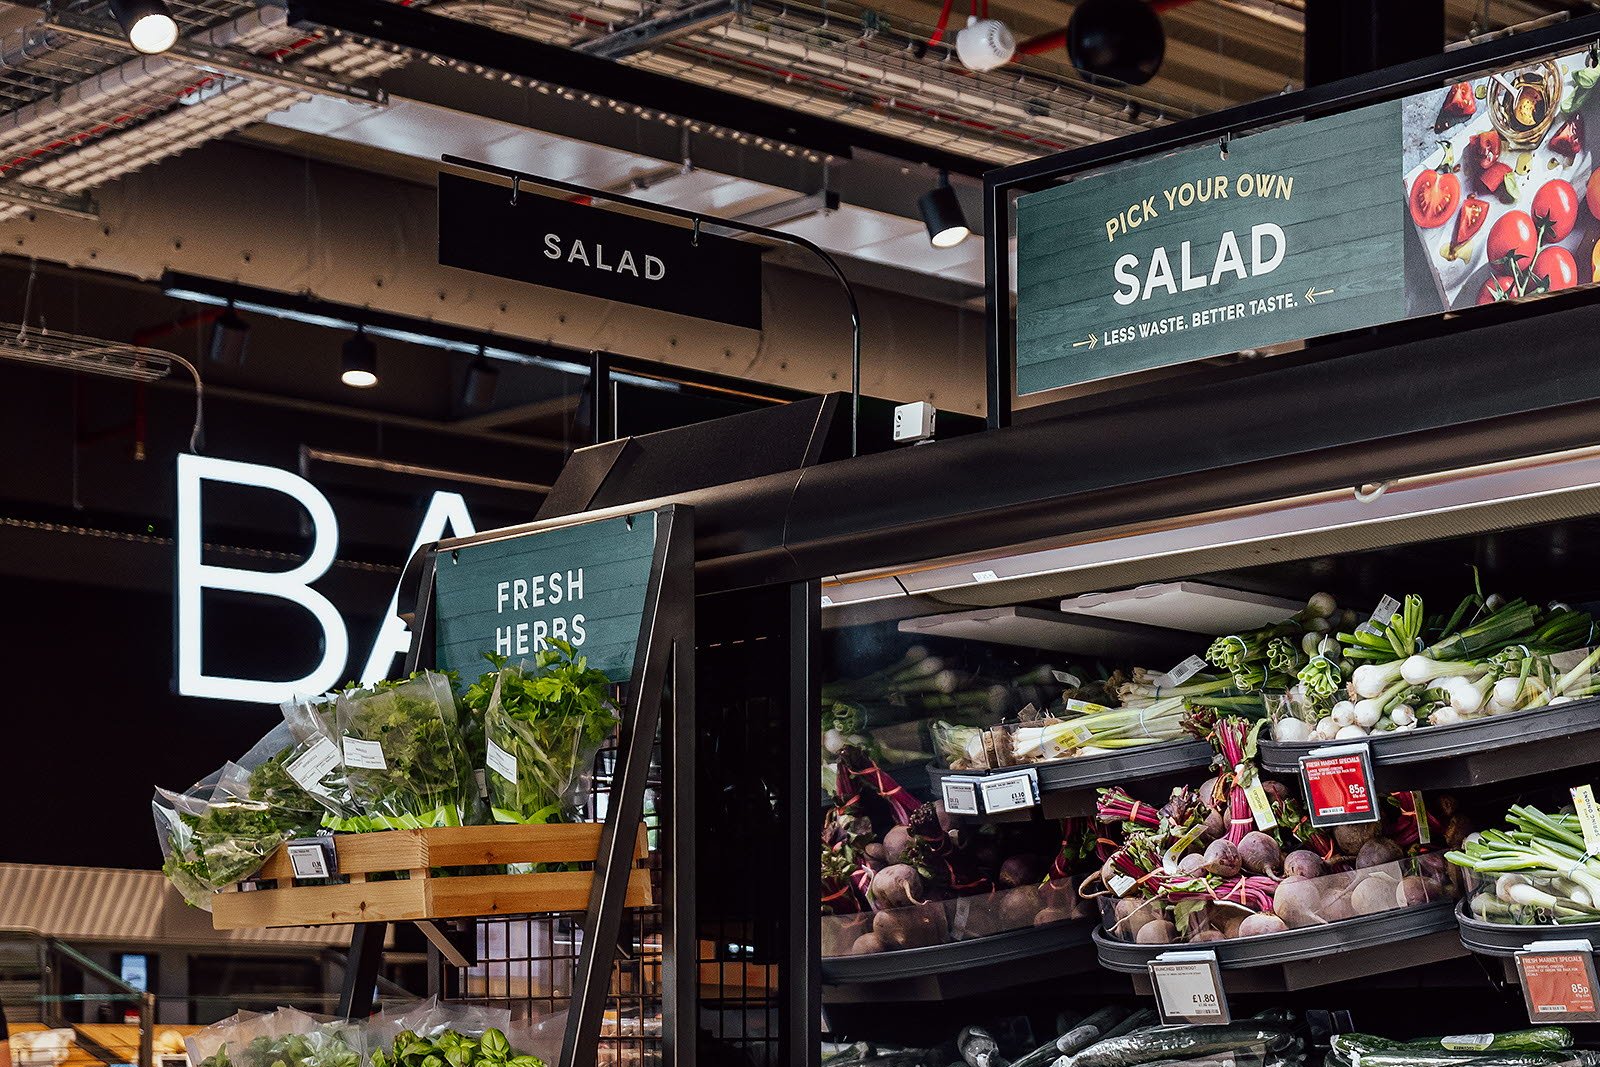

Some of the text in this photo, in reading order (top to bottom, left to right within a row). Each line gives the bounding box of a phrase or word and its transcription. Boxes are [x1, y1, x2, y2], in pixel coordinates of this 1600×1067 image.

[1105, 172, 1295, 243] PICK YOUR OWN
[543, 233, 666, 281] SALAD
[1112, 222, 1287, 305] SALAD
[1103, 292, 1299, 346] LESS WASTE. BETTER TASTE.
[498, 568, 584, 613] FRESH
[496, 613, 587, 656] HERBS
[1321, 759, 1338, 767] MARKET
[1338, 756, 1359, 764] SPECIALS
[1348, 784, 1364, 795] 85p
[1192, 994, 1215, 1003] £1.80
[1571, 984, 1588, 994] 85p
